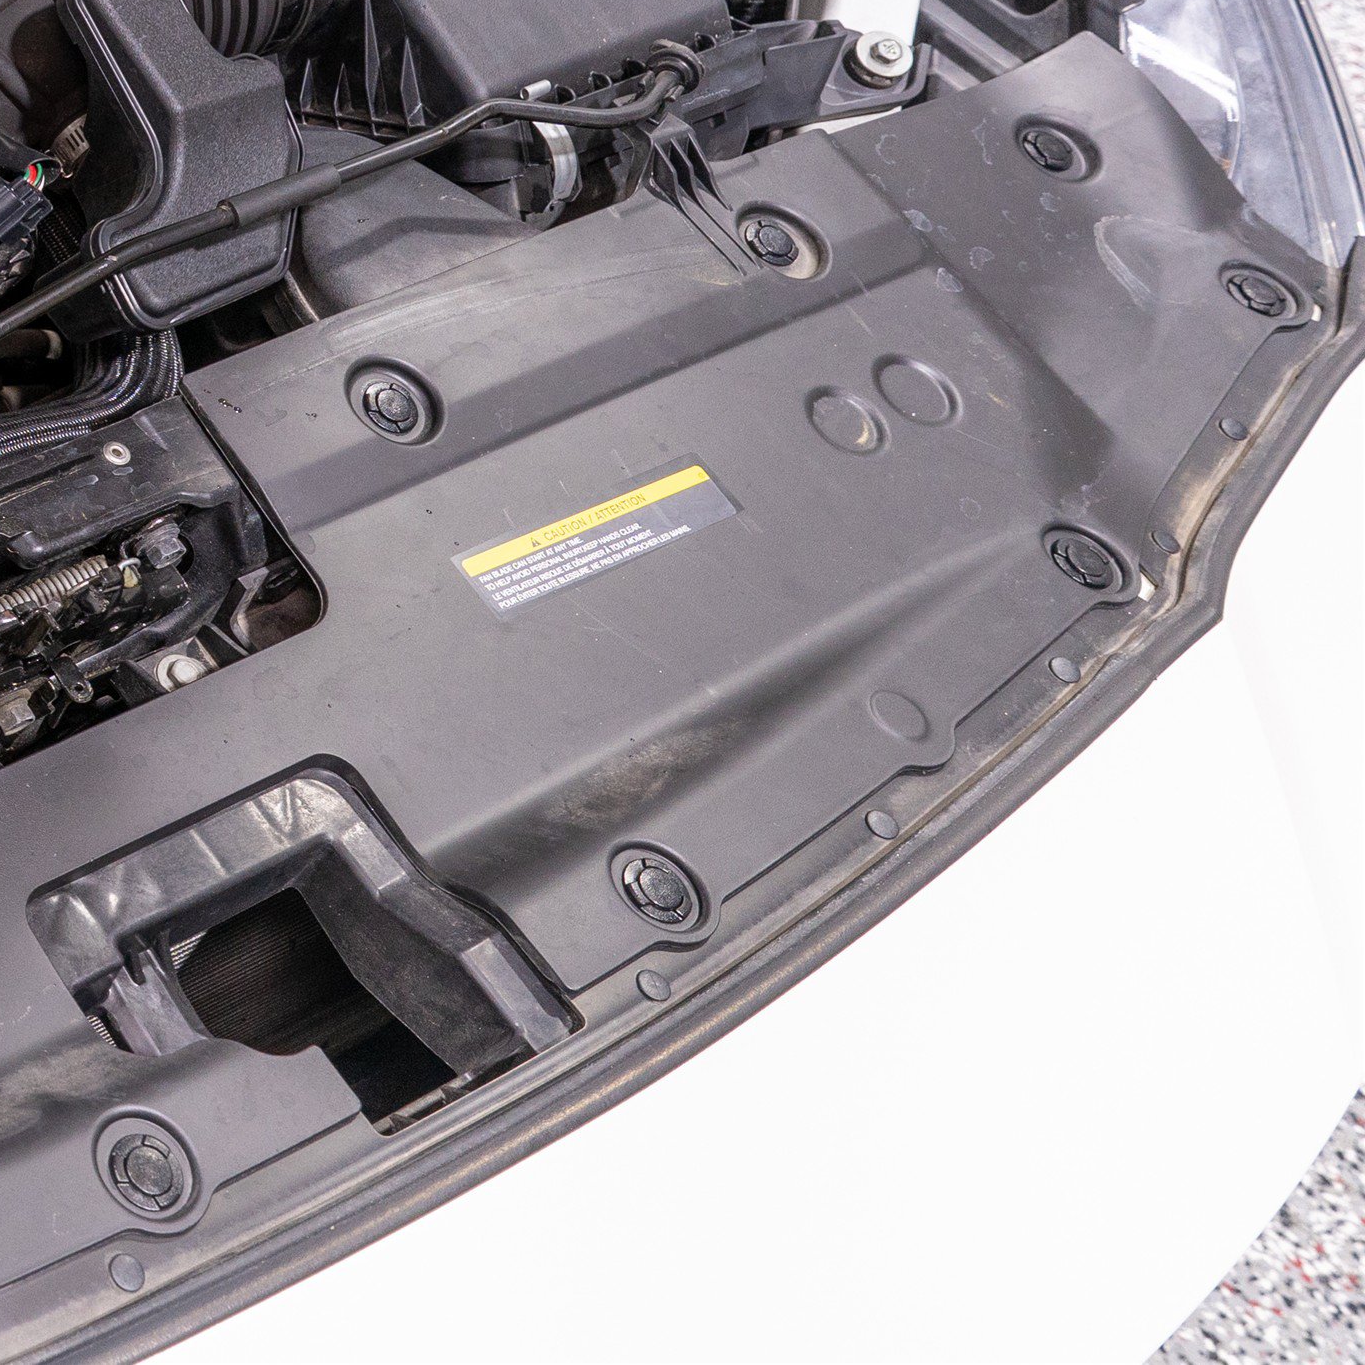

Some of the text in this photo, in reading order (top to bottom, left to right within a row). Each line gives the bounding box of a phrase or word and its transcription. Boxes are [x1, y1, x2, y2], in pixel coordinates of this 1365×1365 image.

[543, 517, 587, 541] CAUTION
[594, 492, 646, 520] ATTENTION
[478, 573, 493, 583] FAN
[491, 564, 513, 578] BLADE
[512, 559, 527, 569] CAN
[525, 551, 546, 563] START
[545, 547, 554, 555] AT
[553, 542, 567, 552] ANY
[484, 582, 495, 591] TO
[494, 575, 511, 587] HELP
[511, 568, 530, 580] AVOID
[529, 555, 564, 572] PERSONAL
[597, 531, 620, 544] HANDS
[619, 522, 641, 535] CLEAR.
[491, 591, 502, 600] LE
[500, 576, 541, 596] VENTILATEUR
[539, 566, 564, 580] RISQUE
[561, 562, 573, 571] DE
[608, 539, 627, 551] TOUT
[626, 529, 654, 544] MOMENT.
[498, 596, 518, 608] POUR
[537, 579, 559, 592] TOUTE
[590, 561, 601, 570] NE
[599, 556, 613, 566] PAS
[611, 552, 623, 561] EN
[621, 537, 659, 557] APPROCHER
